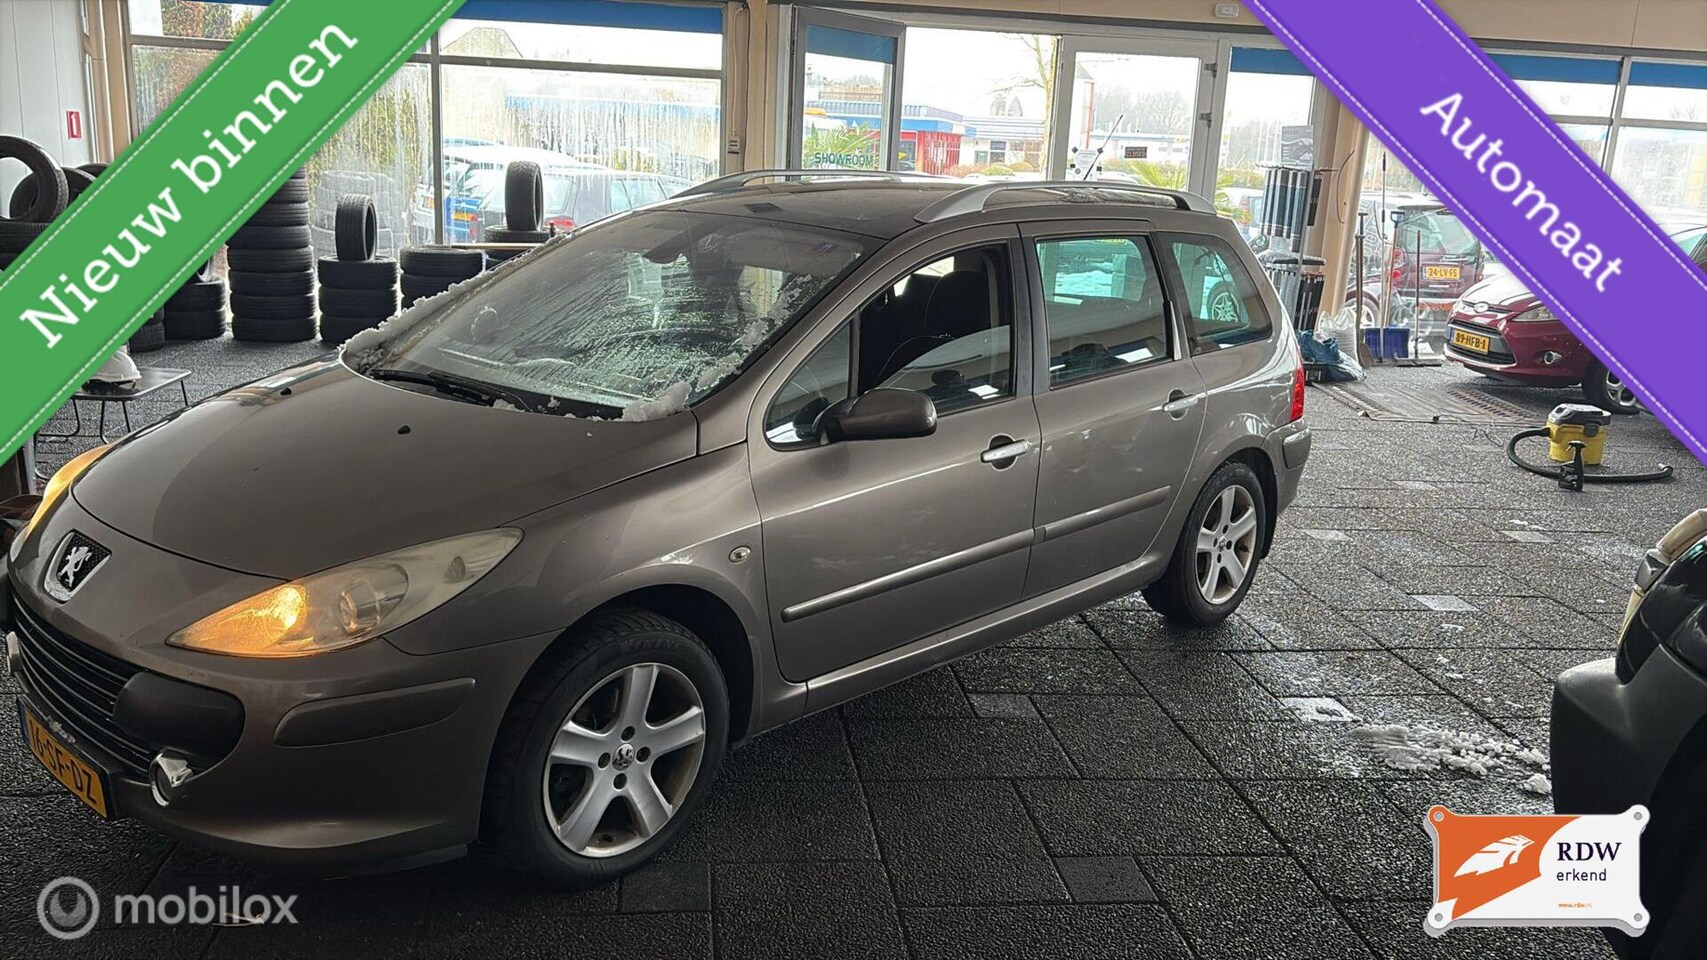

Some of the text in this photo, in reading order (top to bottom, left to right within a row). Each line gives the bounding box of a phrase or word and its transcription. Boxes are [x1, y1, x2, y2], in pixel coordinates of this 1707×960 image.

[814, 152, 874, 166] SHOWROOM
[1455, 332, 1486, 350] 89-HFB-1
[28, 719, 98, 805] 16-SF-DZ
